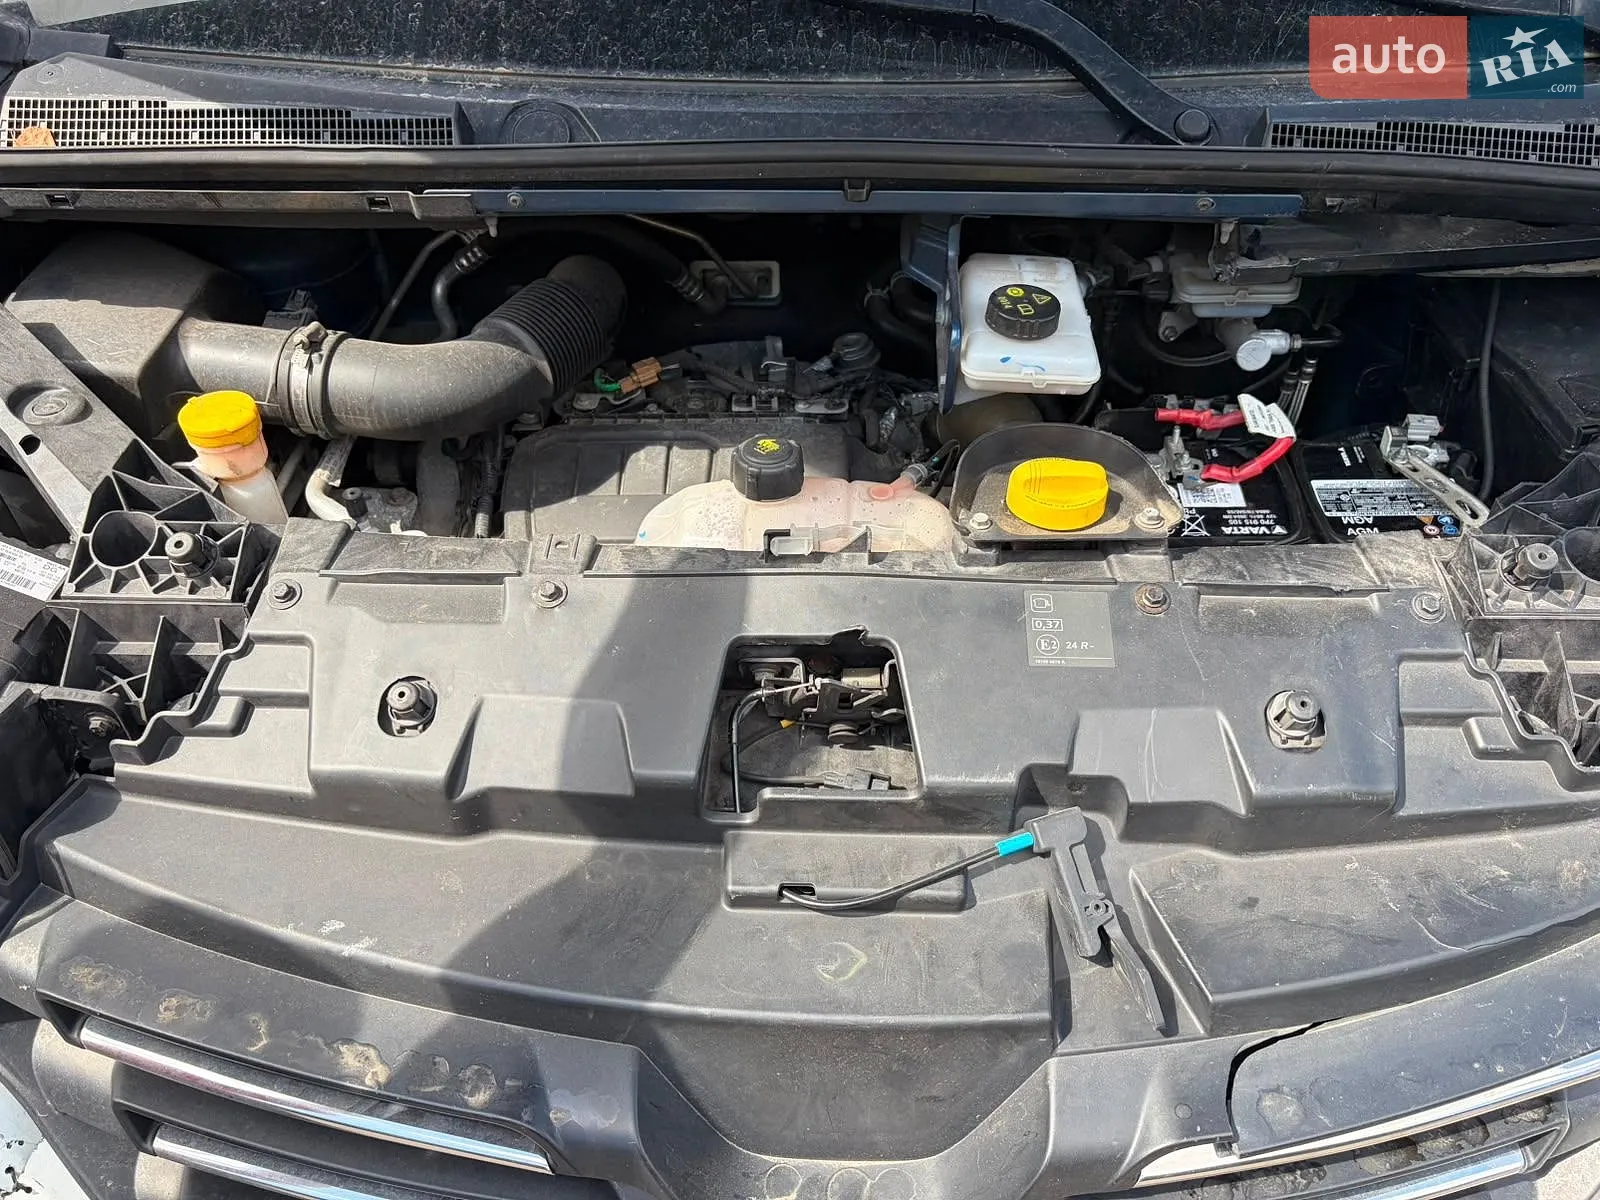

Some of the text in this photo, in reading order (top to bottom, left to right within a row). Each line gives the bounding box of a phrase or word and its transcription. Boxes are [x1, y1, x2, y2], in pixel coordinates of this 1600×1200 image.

[1341, 515, 1374, 525] AGM
[1221, 526, 1271, 534] VARTA
[1035, 620, 1060, 630] 0,37
[1040, 639, 1058, 651] E2
[1065, 641, 1078, 650] 24
